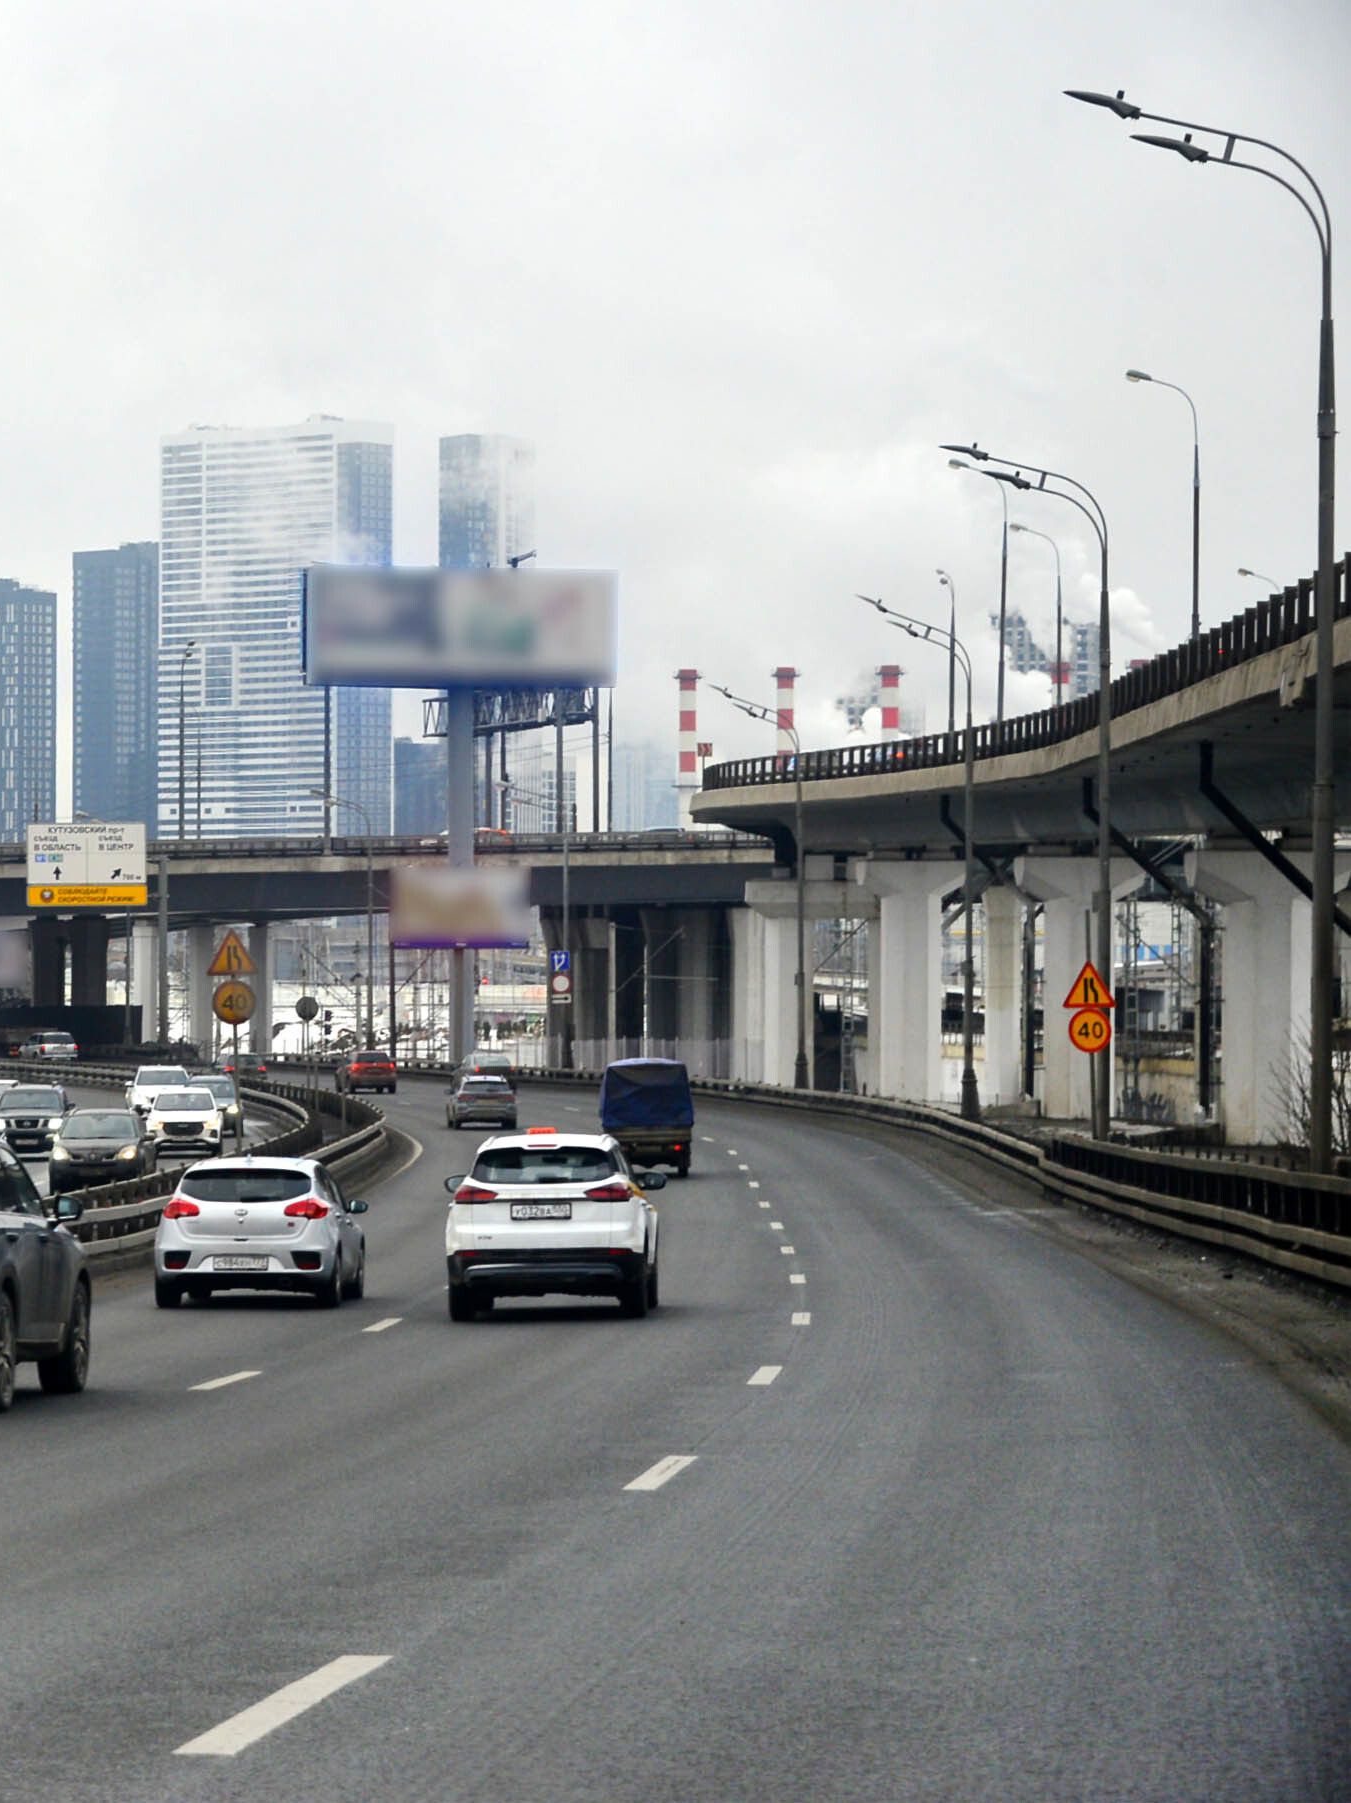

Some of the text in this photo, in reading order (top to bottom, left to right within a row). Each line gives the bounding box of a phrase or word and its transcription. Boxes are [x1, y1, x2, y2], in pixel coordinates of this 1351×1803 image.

[48, 826, 107, 834] КУТУЗОВСКИЙ
[222, 994, 247, 1011] 40
[1078, 1022, 1103, 1039] 40
